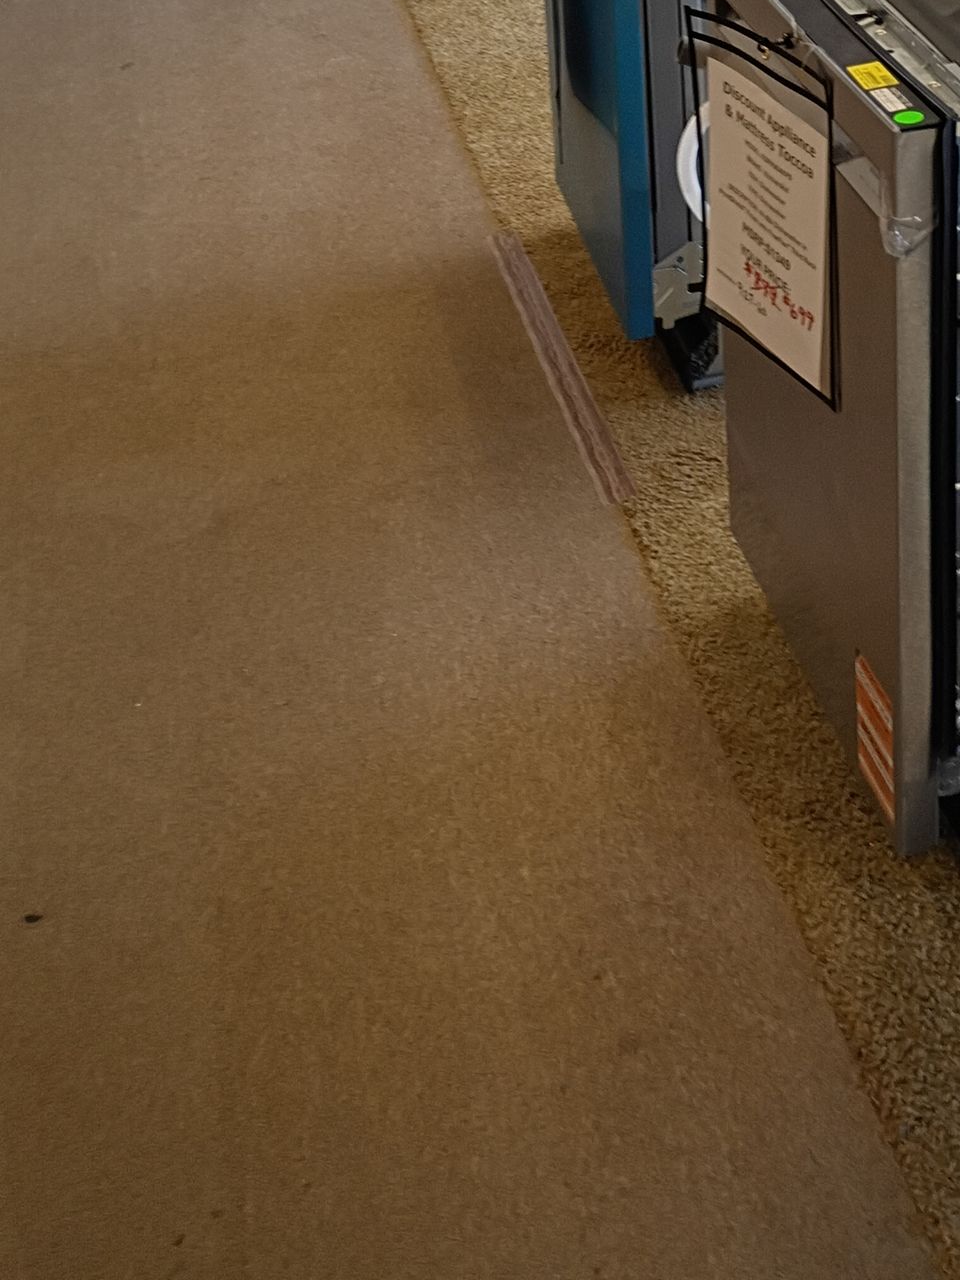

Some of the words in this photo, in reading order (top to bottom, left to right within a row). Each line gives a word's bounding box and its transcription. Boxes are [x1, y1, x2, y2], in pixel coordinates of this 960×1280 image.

[722, 80, 766, 121] Discount
[767, 113, 817, 159] Appliance
[777, 142, 815, 180] Toccoa
